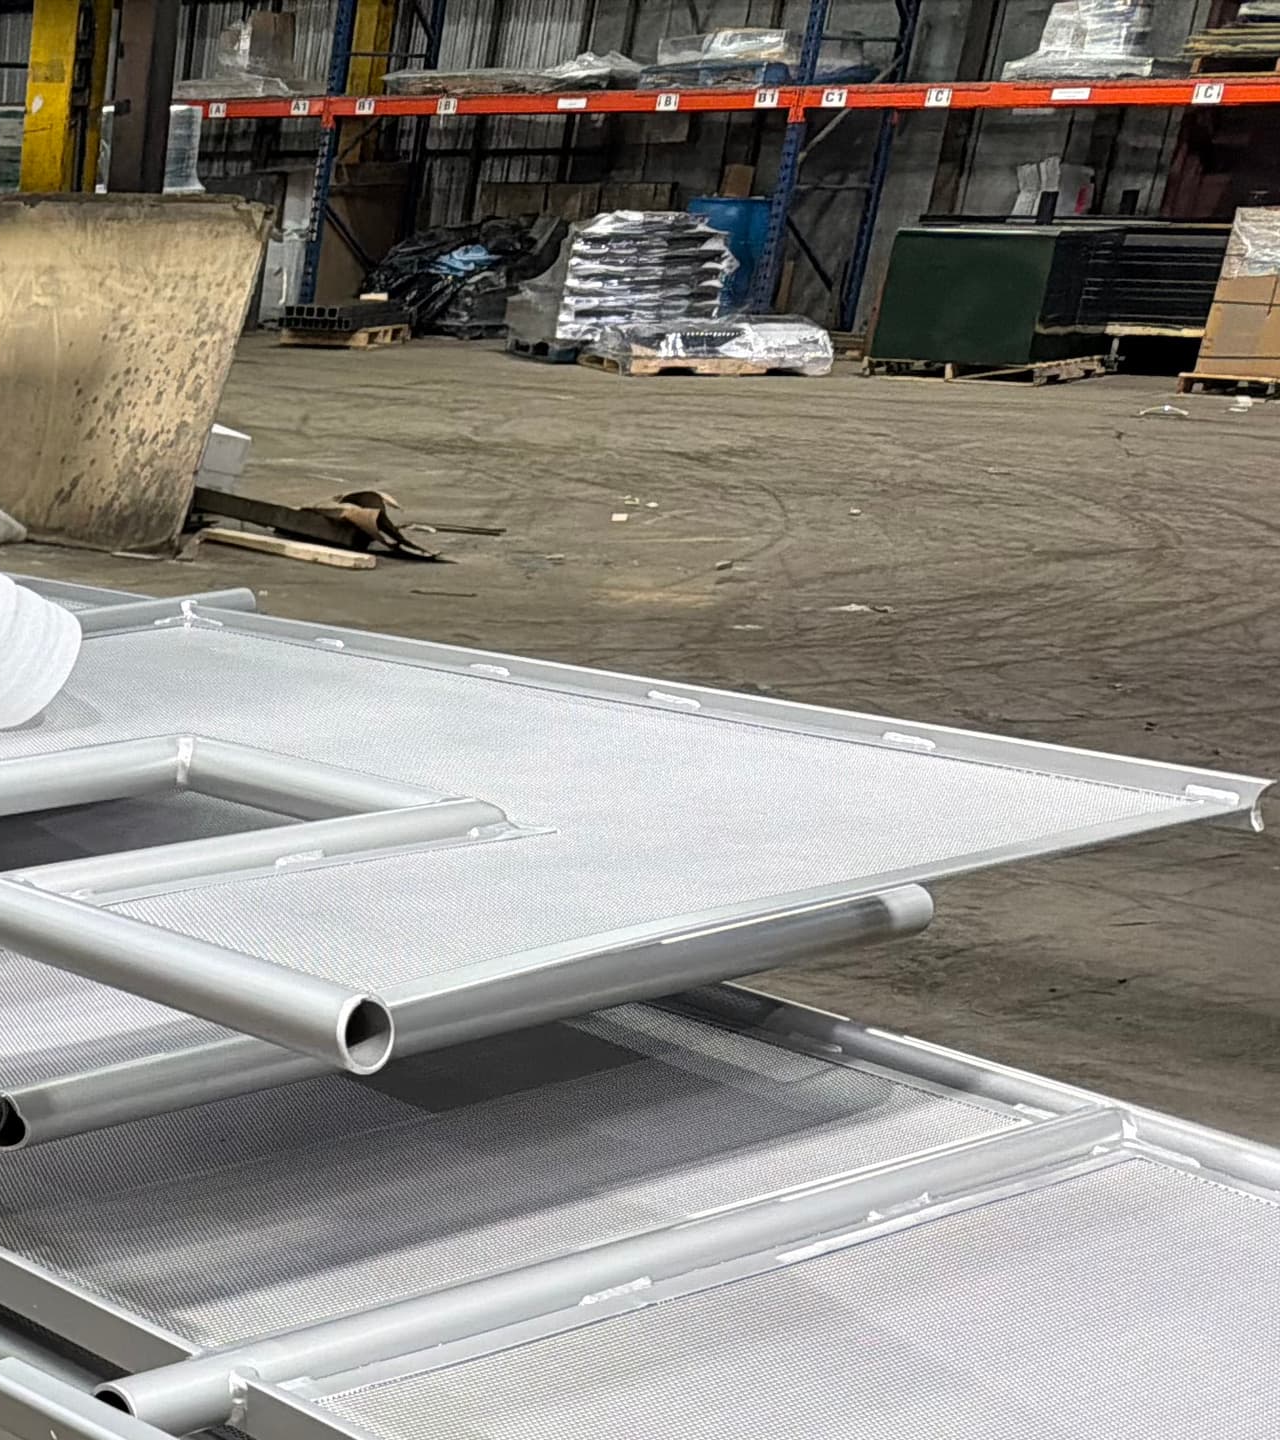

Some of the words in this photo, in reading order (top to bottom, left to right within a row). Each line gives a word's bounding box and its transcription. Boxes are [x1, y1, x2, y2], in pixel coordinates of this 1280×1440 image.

[758, 92, 775, 103] B1
[824, 91, 843, 102] C1
[292, 101, 307, 111] A1
